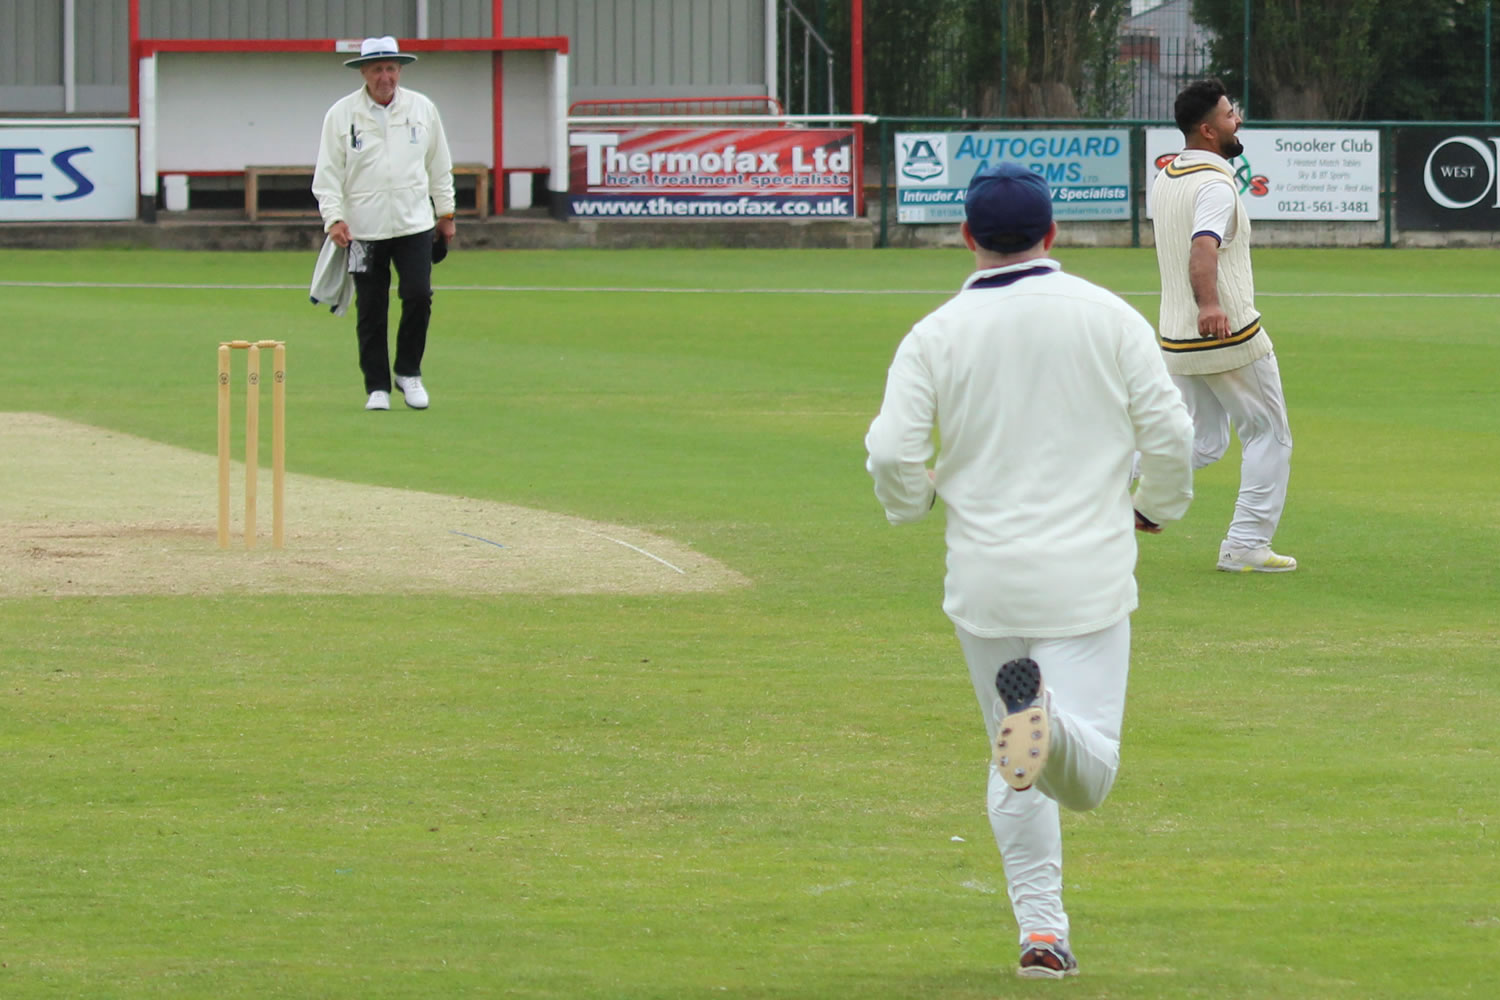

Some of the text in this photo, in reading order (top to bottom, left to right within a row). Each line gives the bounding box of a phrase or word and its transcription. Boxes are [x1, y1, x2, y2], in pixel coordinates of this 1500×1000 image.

[955, 135, 1120, 160] AUTOGUARD
[1274, 138, 1373, 153] Snooker Club
[569, 133, 850, 186] Thermofax Ltd
[1439, 165, 1476, 178] WEST
[606, 173, 850, 187] heat treatment specialists
[903, 190, 954, 203] Intruder
[1059, 187, 1126, 201] Specialists
[572, 197, 849, 216] www.thermofax.co.uk
[1277, 201, 1369, 213] 0121-561-3481
